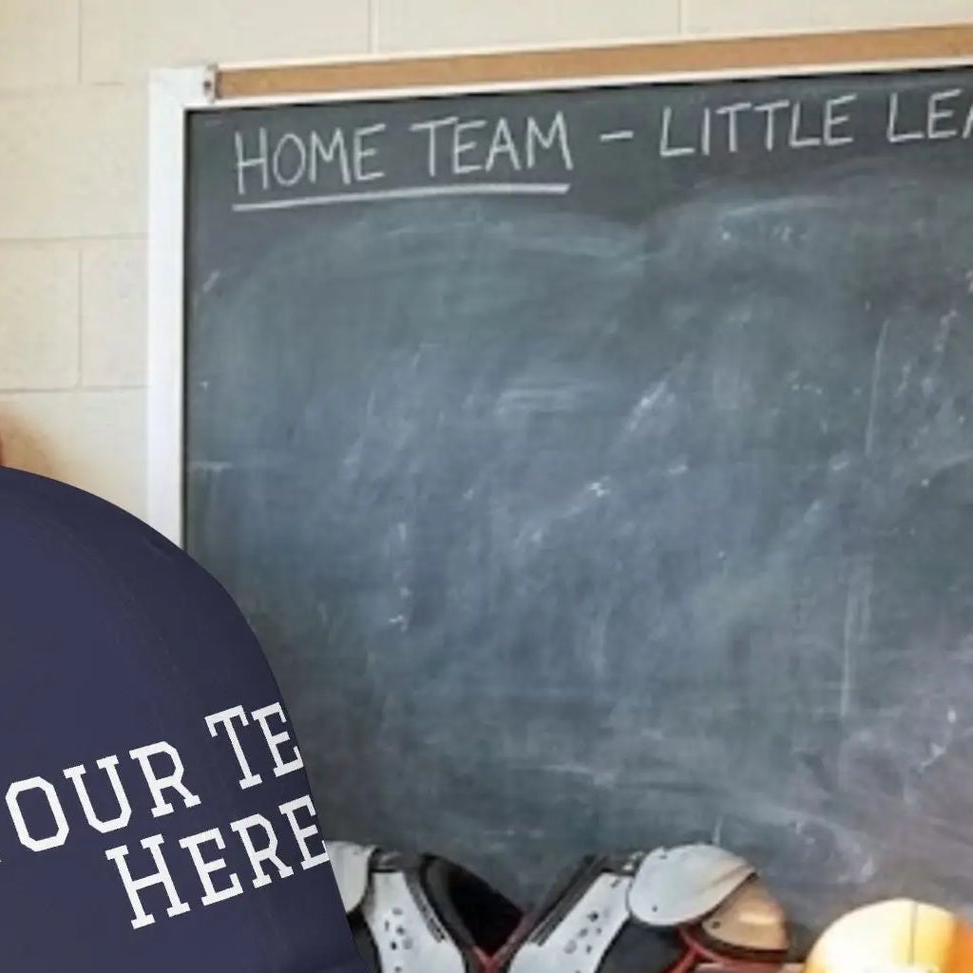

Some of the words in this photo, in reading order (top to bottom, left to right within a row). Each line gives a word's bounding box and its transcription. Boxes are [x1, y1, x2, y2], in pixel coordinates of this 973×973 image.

[234, 124, 385, 193] HOME
[410, 112, 573, 177] TEAM
[659, 95, 856, 157] LITTLE
[105, 795, 329, 929] HERE
